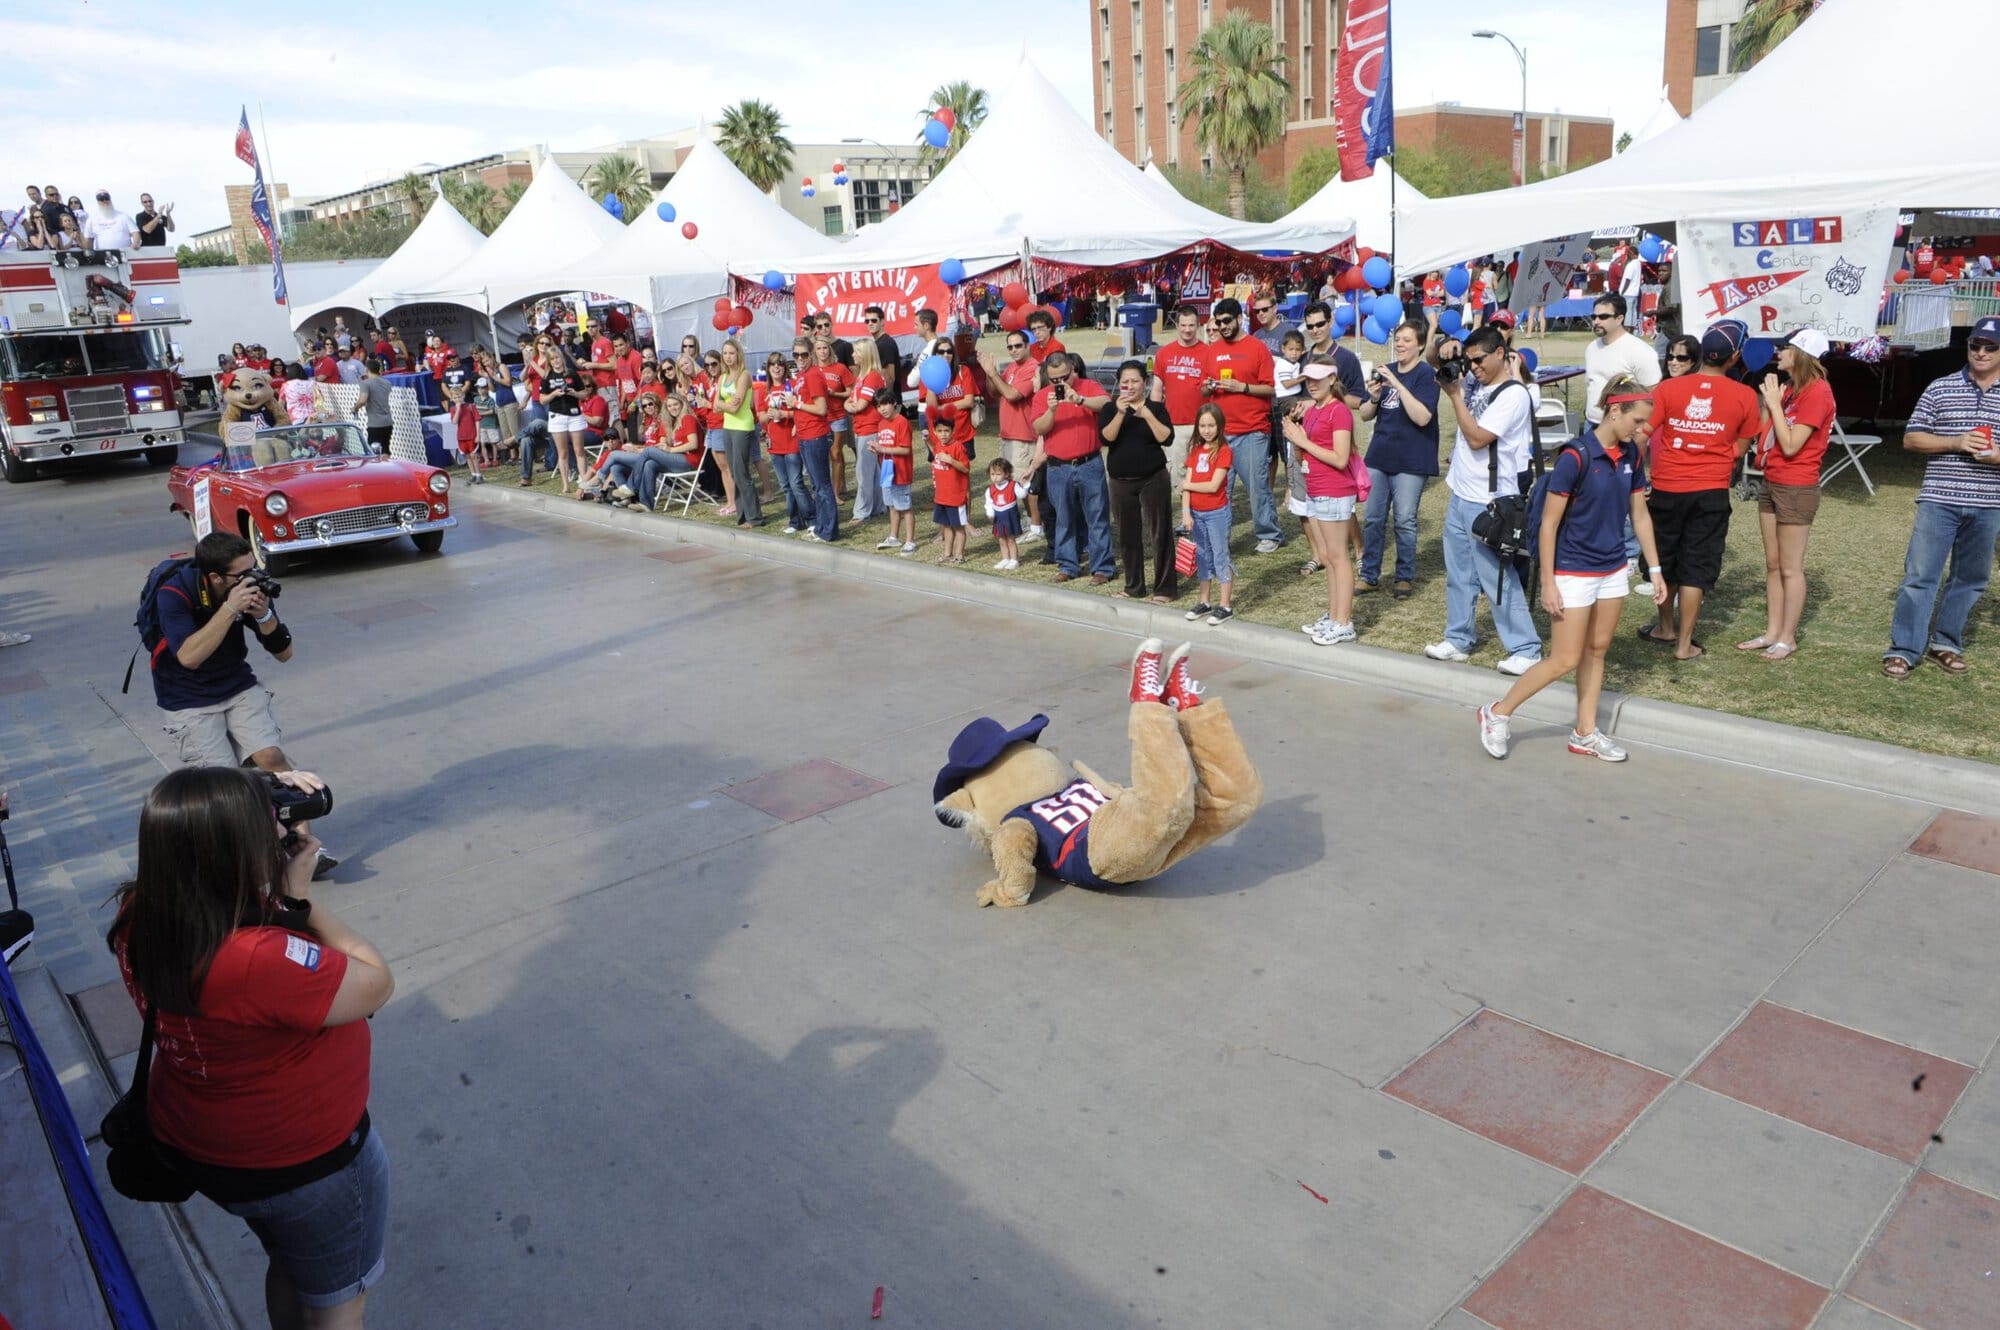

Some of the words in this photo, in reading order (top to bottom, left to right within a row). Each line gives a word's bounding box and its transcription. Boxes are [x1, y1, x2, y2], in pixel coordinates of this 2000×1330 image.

[1739, 220, 1836, 246] SALT
[1757, 249, 1820, 270] Center
[804, 272, 847, 318] APPY
[851, 269, 928, 313] BIRTHDA
[1721, 274, 1779, 310] Aged
[1800, 282, 1823, 305] to
[1178, 355, 1196, 367] AM
[1669, 418, 1725, 431] BEARDOWN
[99, 439, 117, 451] 01
